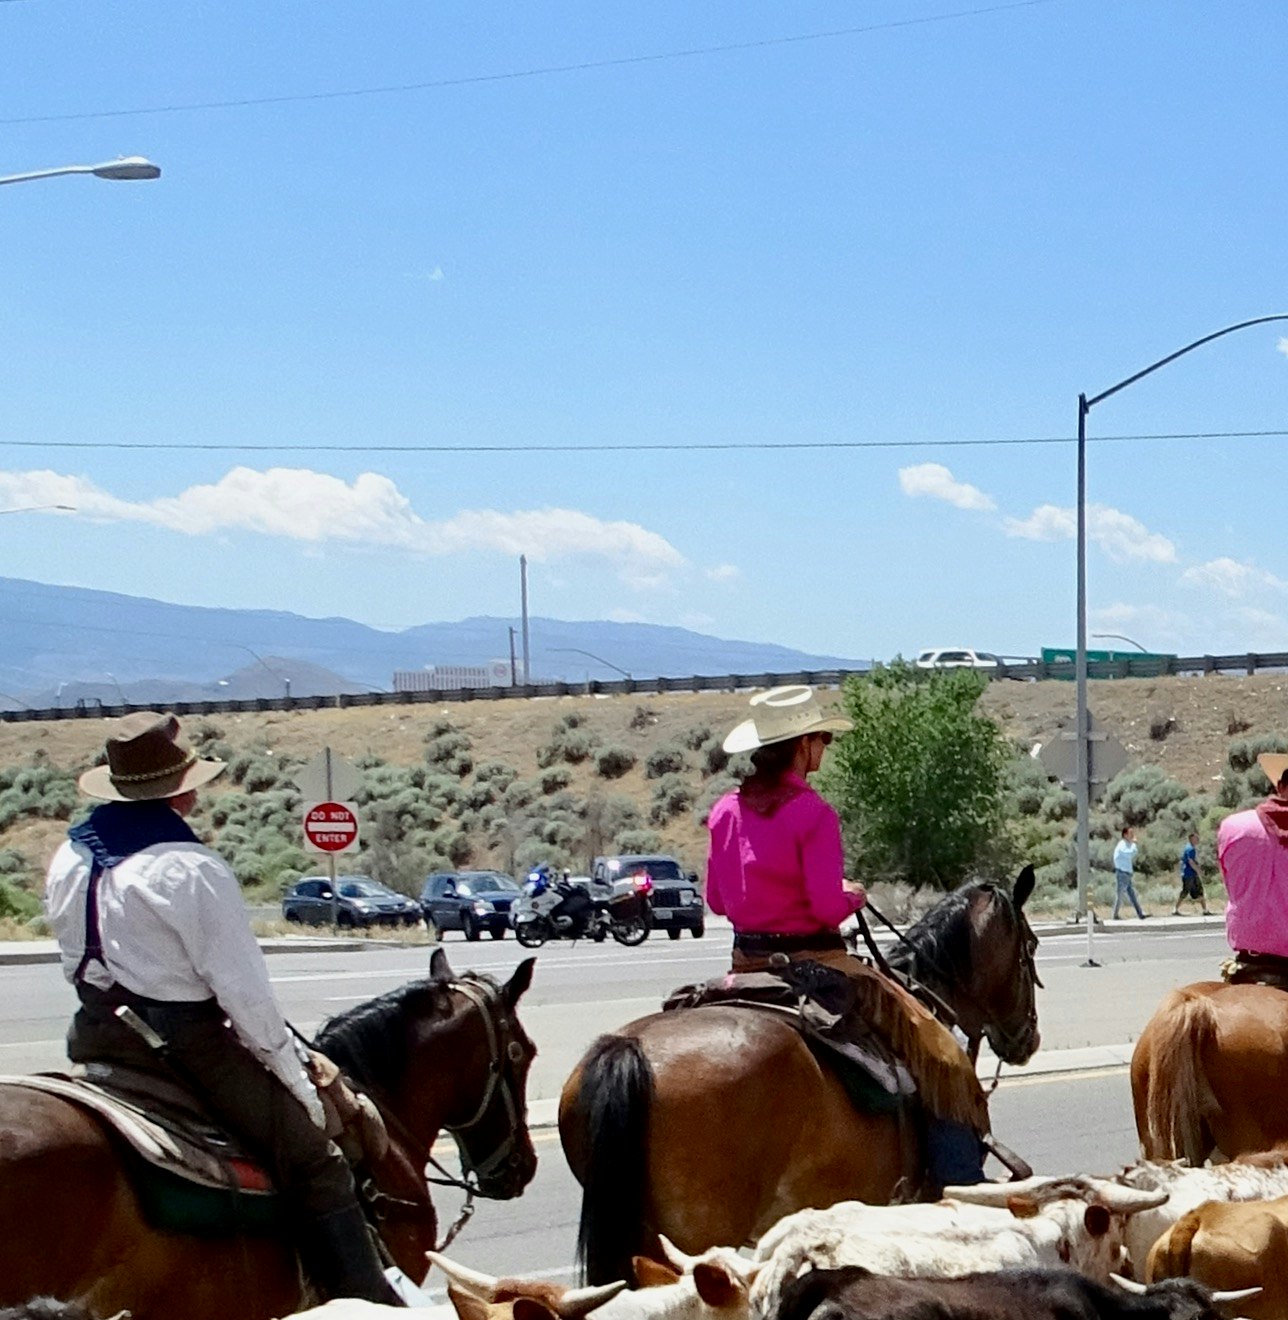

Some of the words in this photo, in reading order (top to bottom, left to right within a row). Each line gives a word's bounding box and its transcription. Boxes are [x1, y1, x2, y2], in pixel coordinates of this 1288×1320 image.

[311, 811, 326, 820] DO
[330, 811, 349, 820] NOT
[315, 833, 347, 843] ENTER
